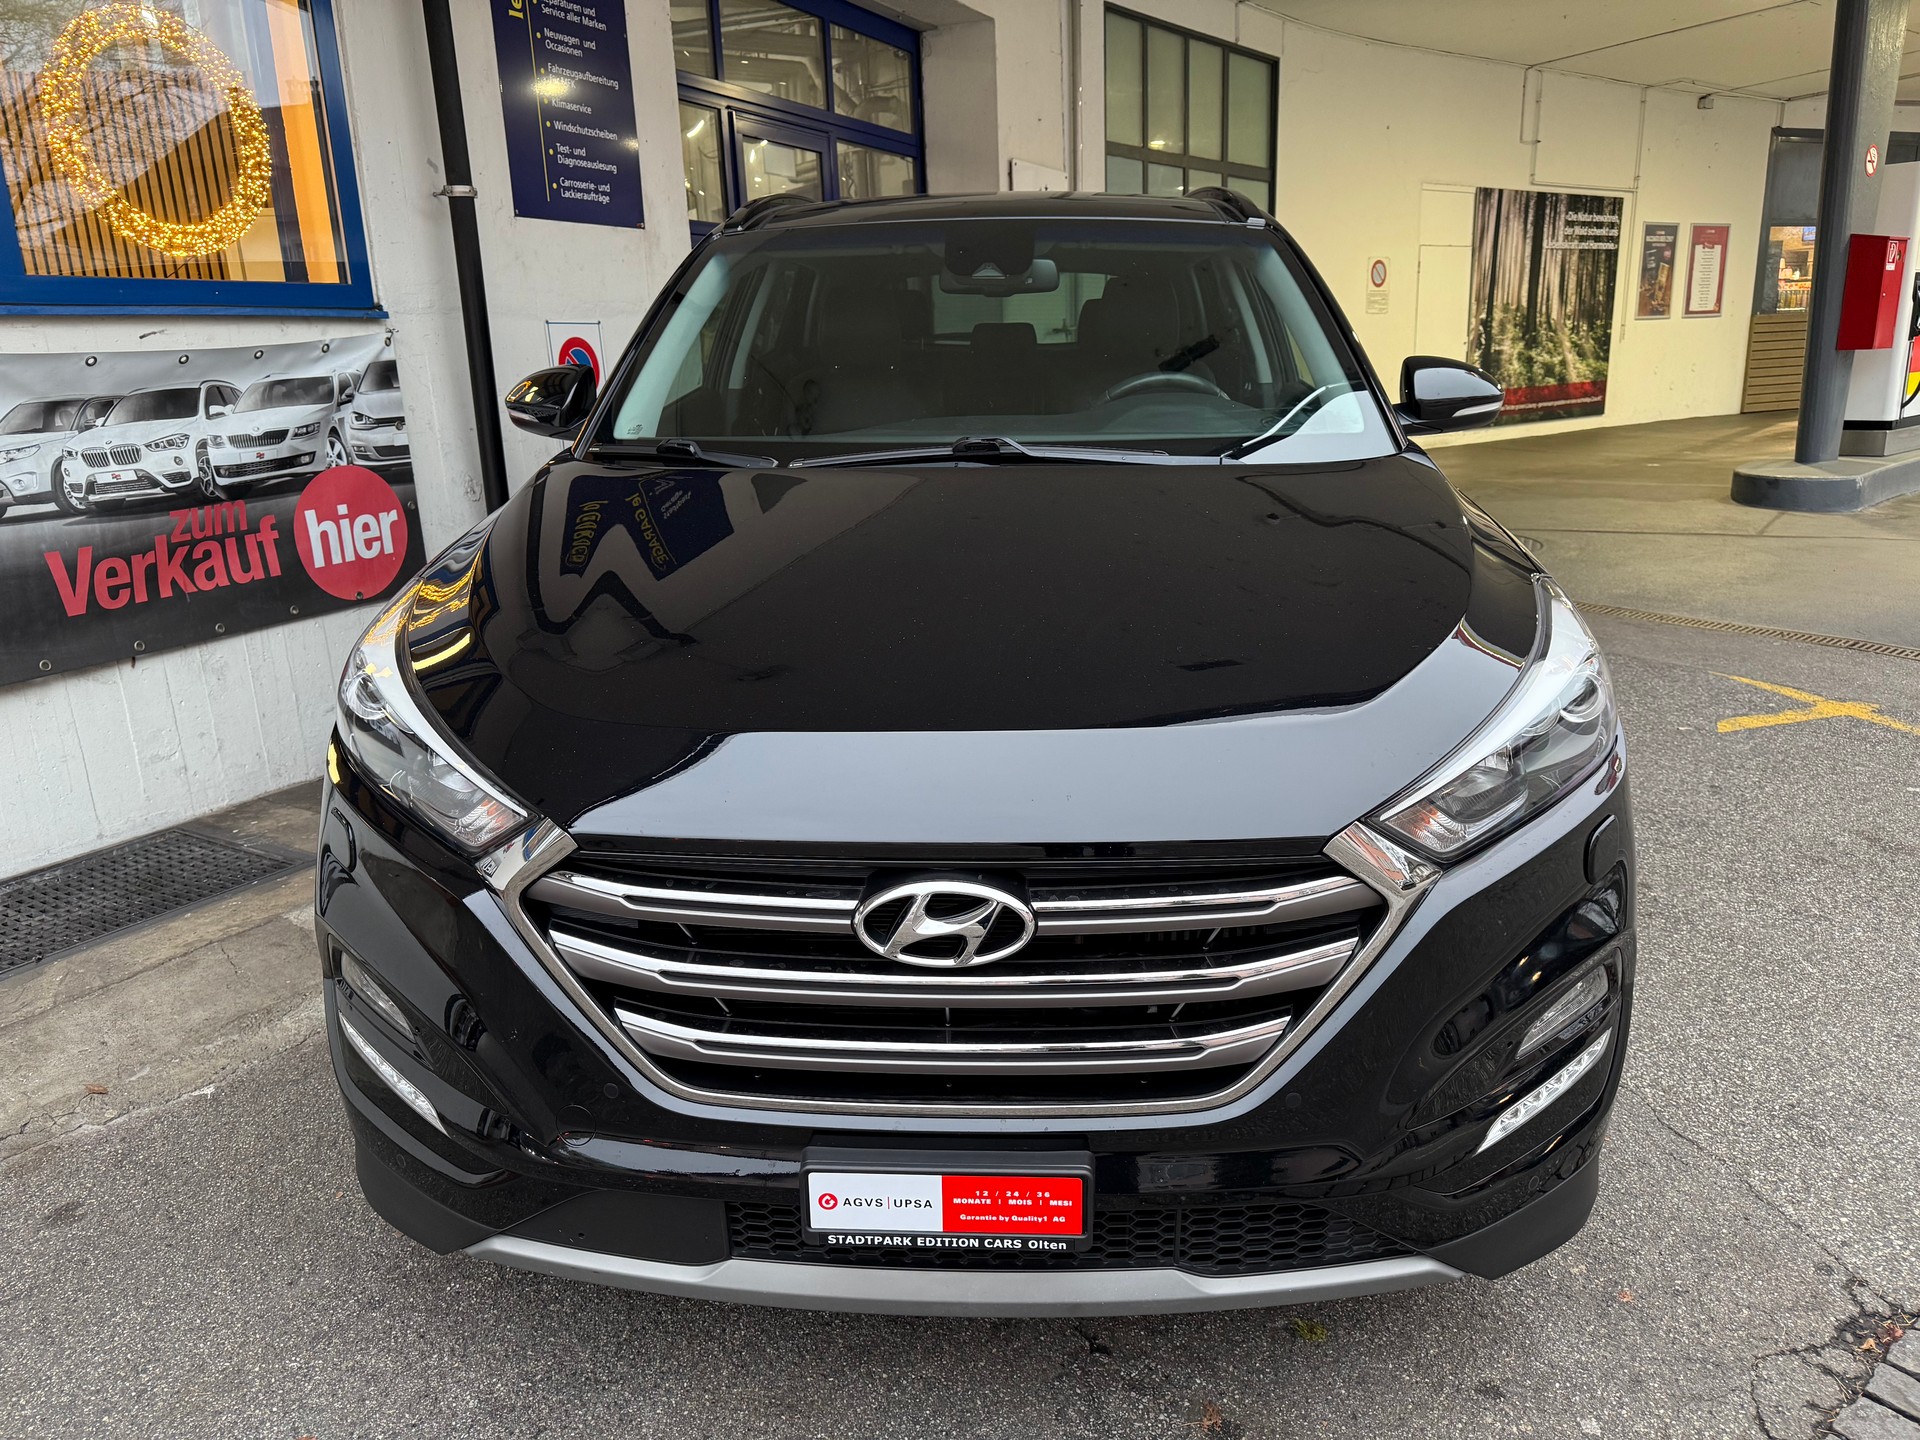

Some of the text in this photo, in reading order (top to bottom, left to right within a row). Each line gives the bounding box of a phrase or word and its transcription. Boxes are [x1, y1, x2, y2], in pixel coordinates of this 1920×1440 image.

[541, 3, 607, 31] Service aller Marken
[582, 6, 596, 17] und
[544, 27, 596, 50] Neuwagen und
[545, 39, 583, 57] Occasionen
[548, 62, 619, 90] Fahrzeugaufbereitung
[552, 98, 592, 114] Klimaservice
[553, 120, 618, 140] Windschutzscheiben
[556, 143, 586, 156] Test- und
[557, 154, 617, 174] Diagnoseauslesung
[559, 176, 610, 192] Carrosserie- und
[560, 188, 610, 204] Lackieraufträge
[169, 499, 248, 543] zum
[305, 503, 399, 568] hier
[43, 515, 282, 617] Verkauf
[842, 1197, 933, 1209] AGVS UPSA
[1011, 1215, 1048, 1223] Quality1
[827, 1234, 1067, 1250] STADTPARK EDITION CARS Olten
